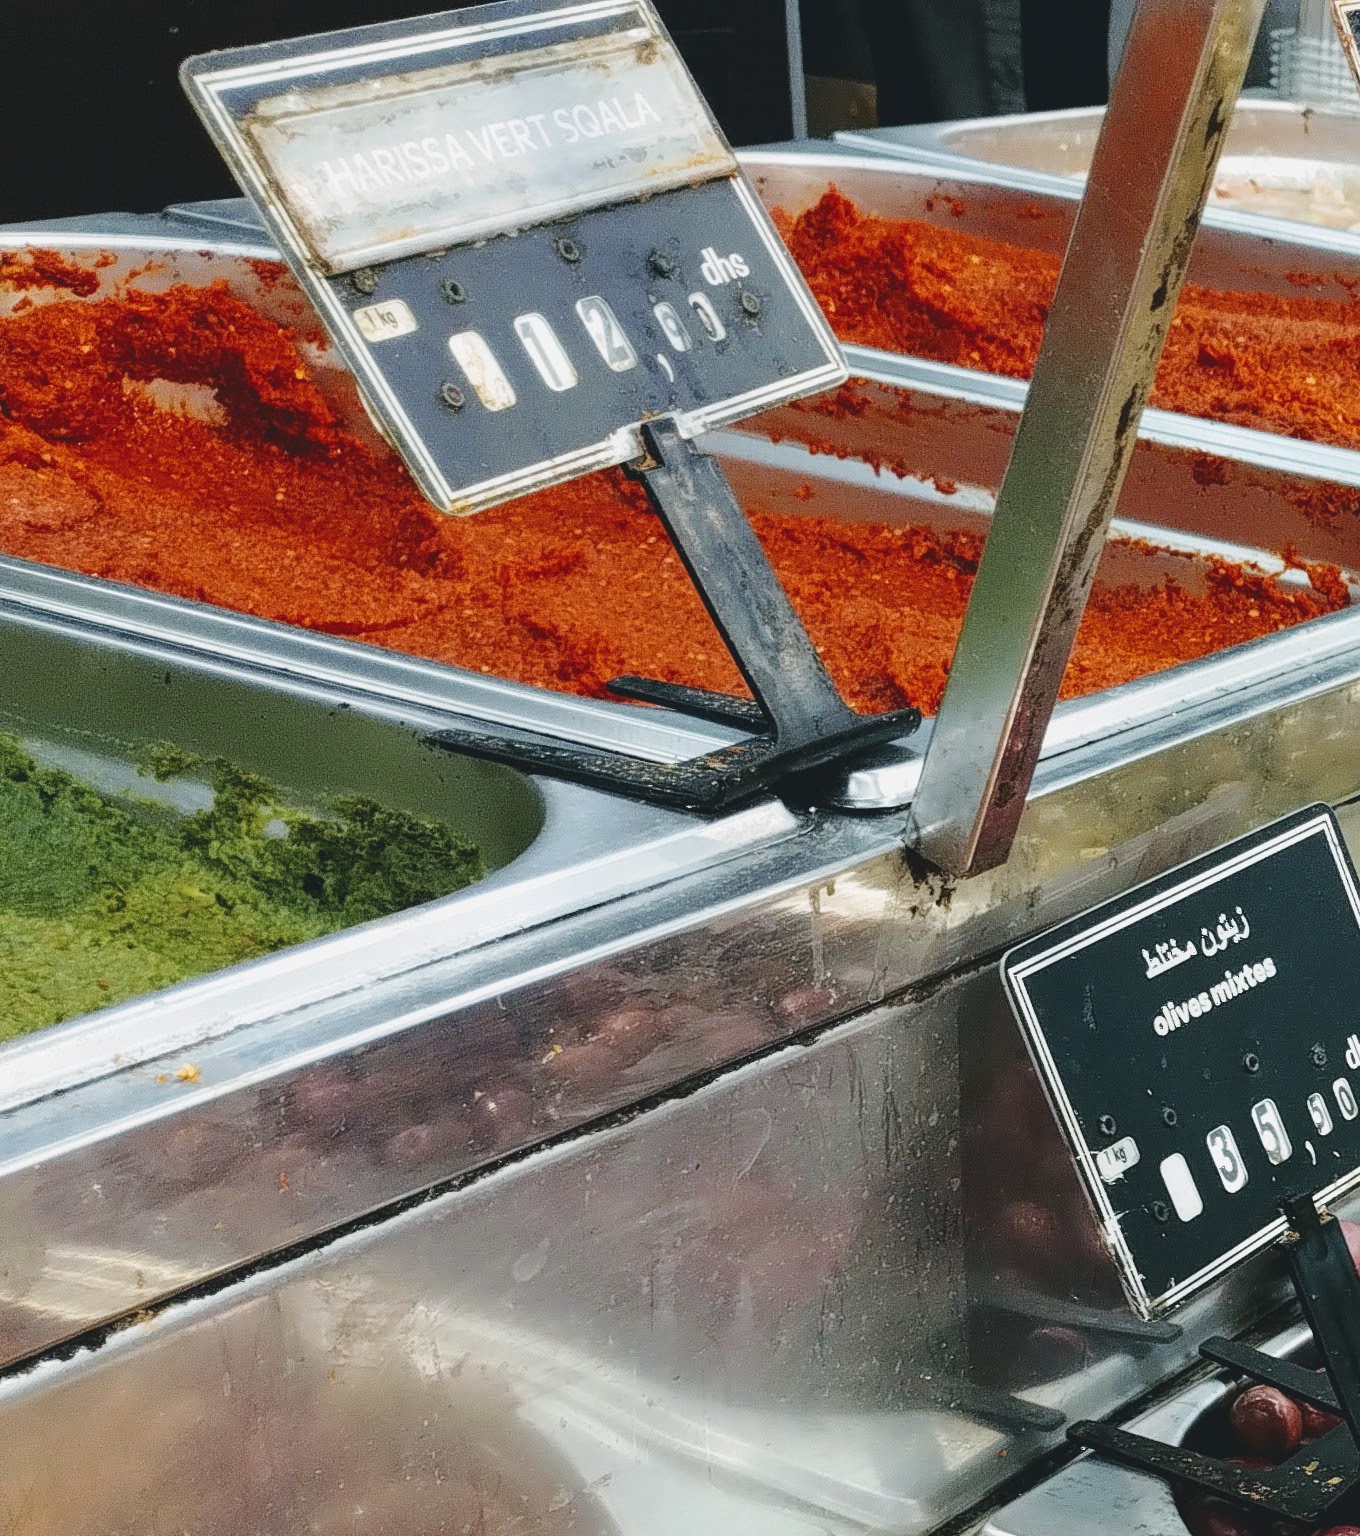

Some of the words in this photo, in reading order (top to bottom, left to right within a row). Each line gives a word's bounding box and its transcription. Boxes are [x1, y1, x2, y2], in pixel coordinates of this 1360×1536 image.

[324, 132, 476, 197] HARISSA
[465, 112, 552, 162] VERT
[553, 90, 663, 144] SQALA
[700, 246, 750, 286] dhs
[373, 307, 399, 330] kg
[1200, 905, 1250, 957] زيتون
[1141, 938, 1198, 979] مختلط
[1153, 991, 1212, 1037] olives
[1209, 957, 1277, 1007] mixtes
[1111, 1146, 1128, 1164] kg
